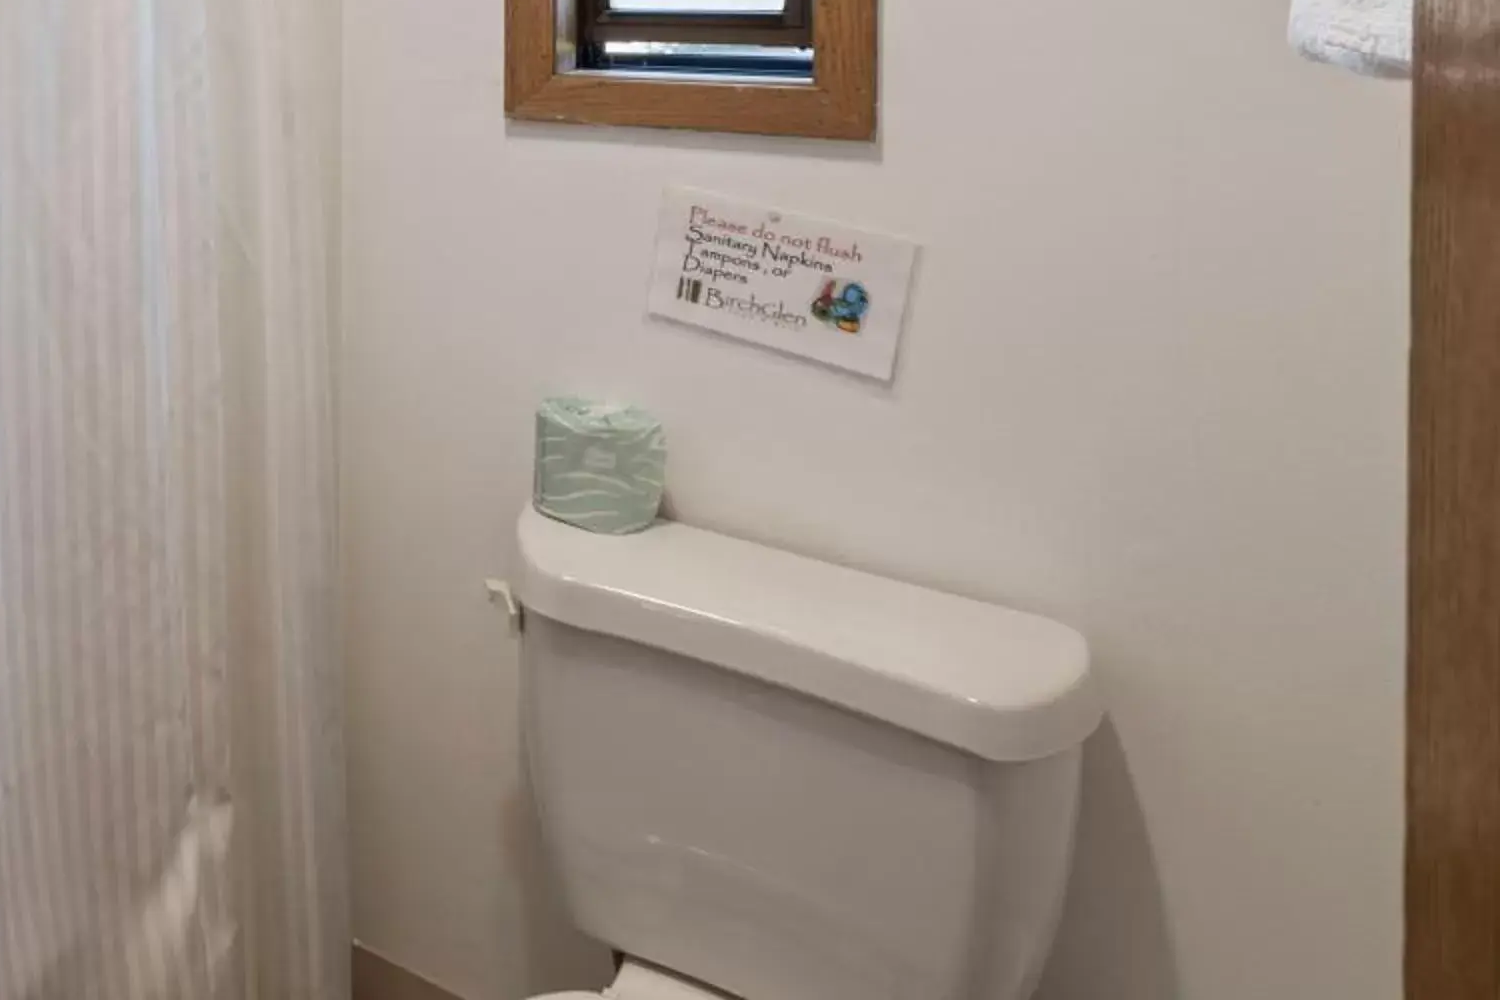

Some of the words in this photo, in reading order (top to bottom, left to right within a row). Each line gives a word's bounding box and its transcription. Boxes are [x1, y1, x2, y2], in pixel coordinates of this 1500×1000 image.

[686, 225, 757, 258] Sanitary
[762, 240, 833, 273] Napkins
[689, 205, 748, 235] Please
[751, 221, 775, 240] do
[780, 234, 812, 251] not
[816, 236, 863, 264] flush
[682, 254, 748, 284] Diapers
[771, 266, 792, 278] or
